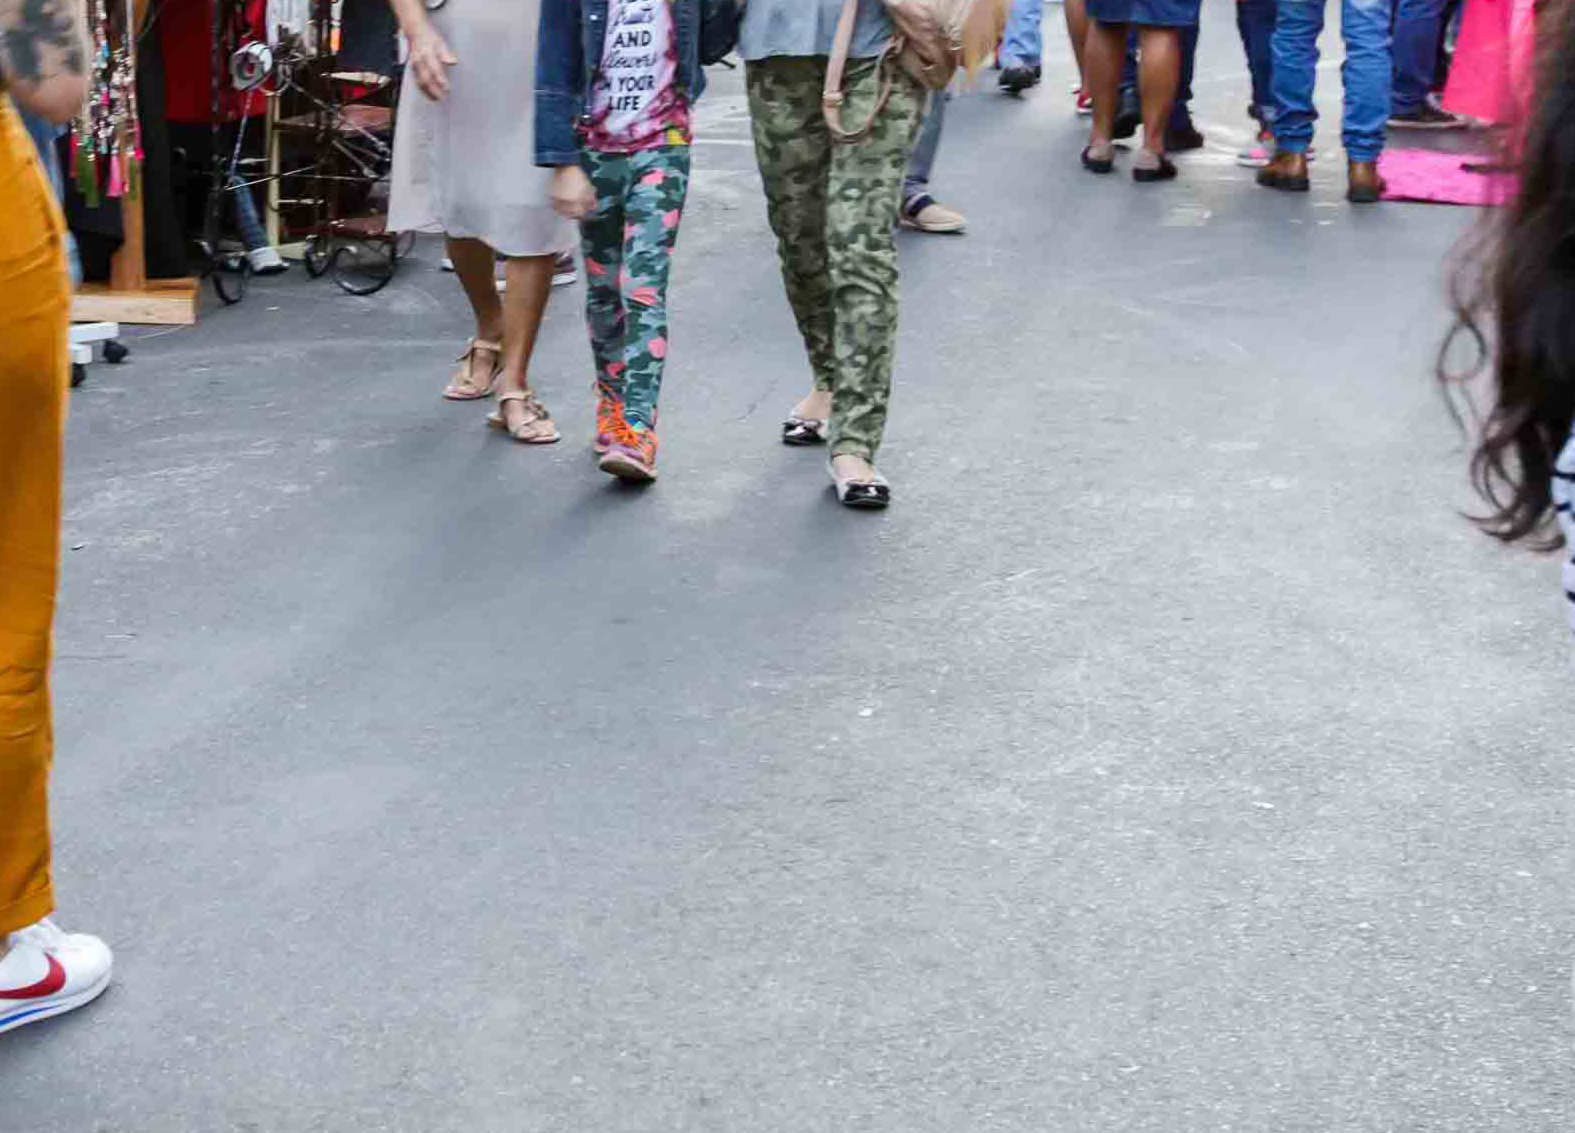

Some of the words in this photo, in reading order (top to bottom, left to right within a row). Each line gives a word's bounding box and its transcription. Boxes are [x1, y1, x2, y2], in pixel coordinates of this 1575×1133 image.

[612, 30, 652, 48] AND
[618, 75, 654, 92] YOUR
[608, 95, 641, 112] LIFE
